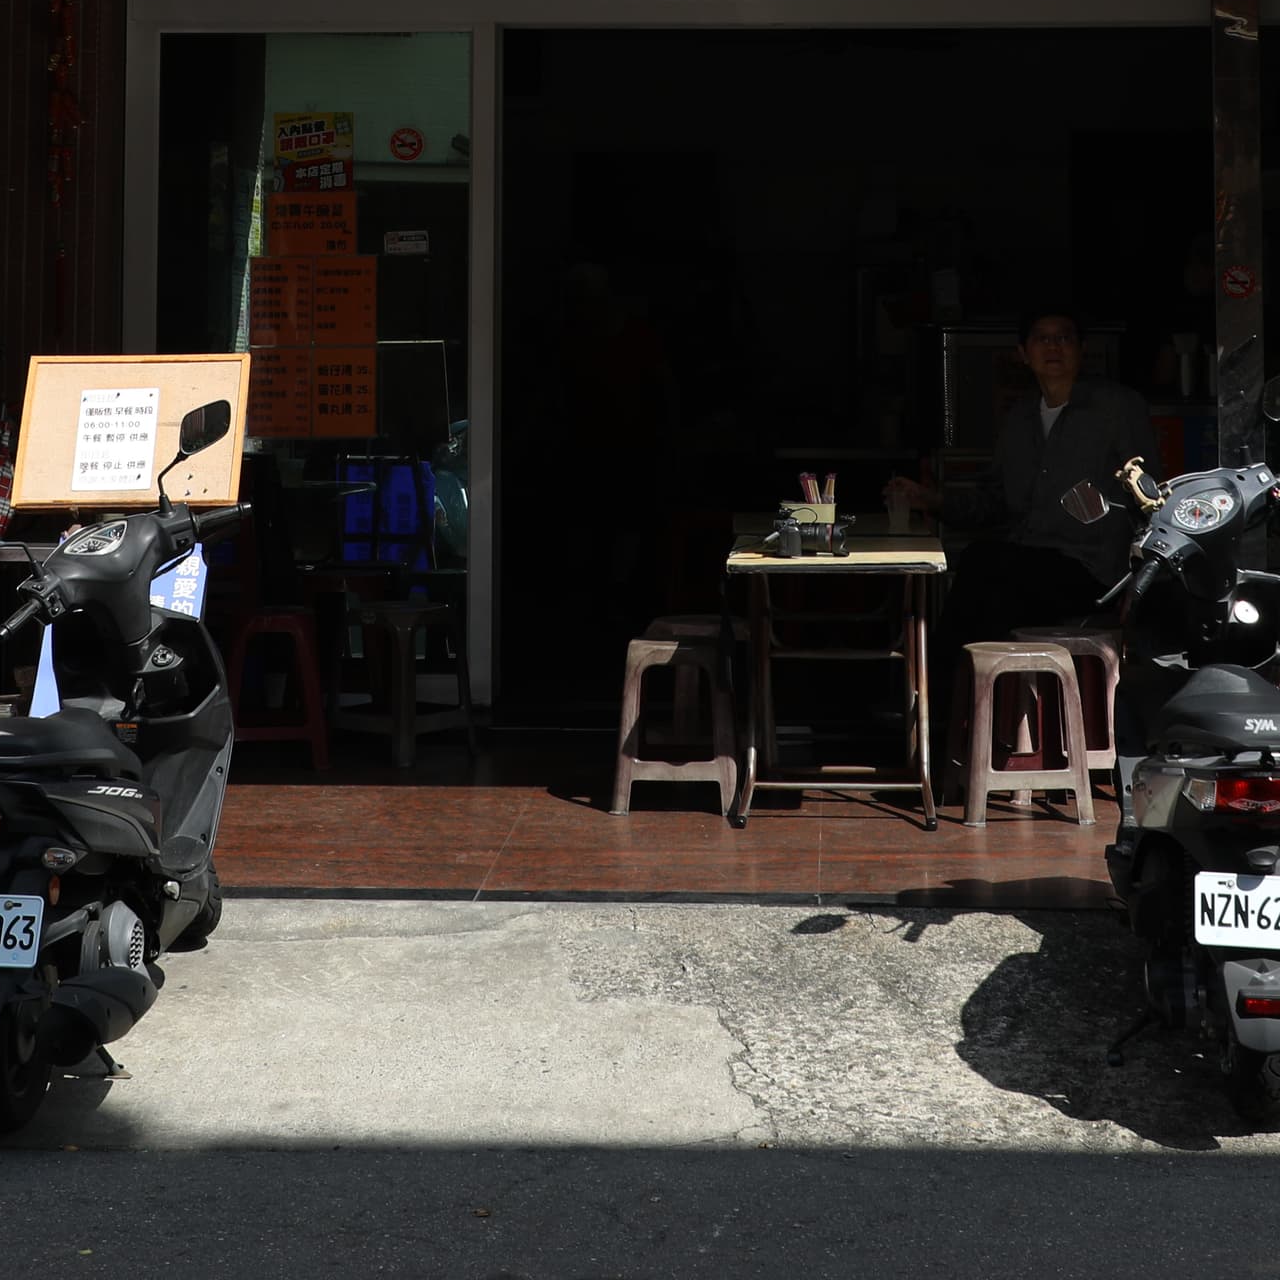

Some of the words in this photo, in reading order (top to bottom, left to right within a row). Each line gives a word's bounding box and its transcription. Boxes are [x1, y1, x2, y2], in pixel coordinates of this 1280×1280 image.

[171, 555, 200, 616] 親愛的
[1244, 718, 1277, 734] SYM
[87, 786, 138, 798] JOG
